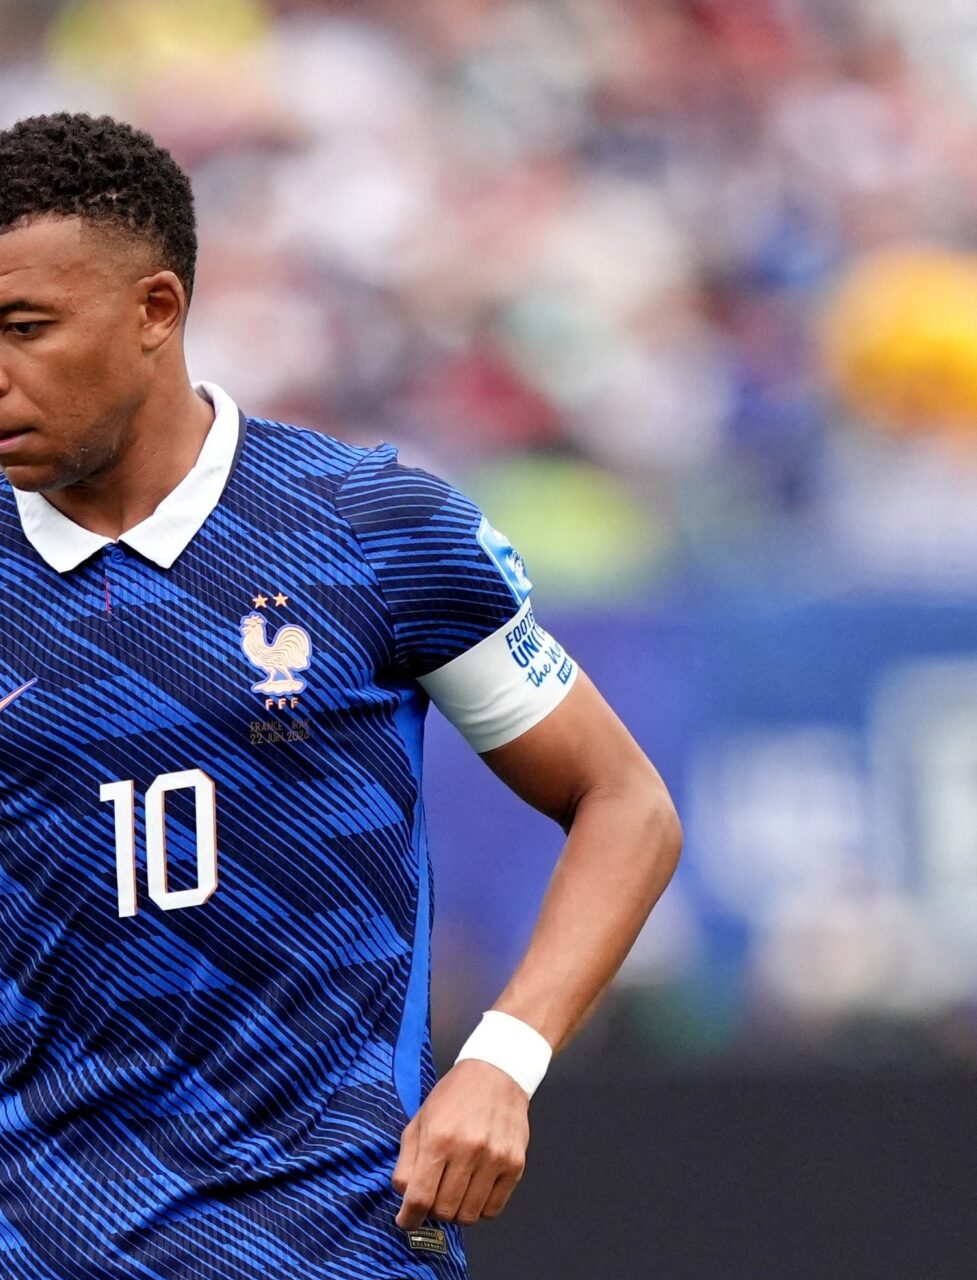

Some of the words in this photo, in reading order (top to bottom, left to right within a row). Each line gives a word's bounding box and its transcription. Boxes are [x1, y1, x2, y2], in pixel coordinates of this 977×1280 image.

[511, 625, 546, 668] UNIT
[526, 663, 552, 688] the
[265, 697, 298, 711] FFF
[250, 720, 283, 732] FRANCE
[250, 733, 264, 745] 22
[99, 768, 219, 918] 10
